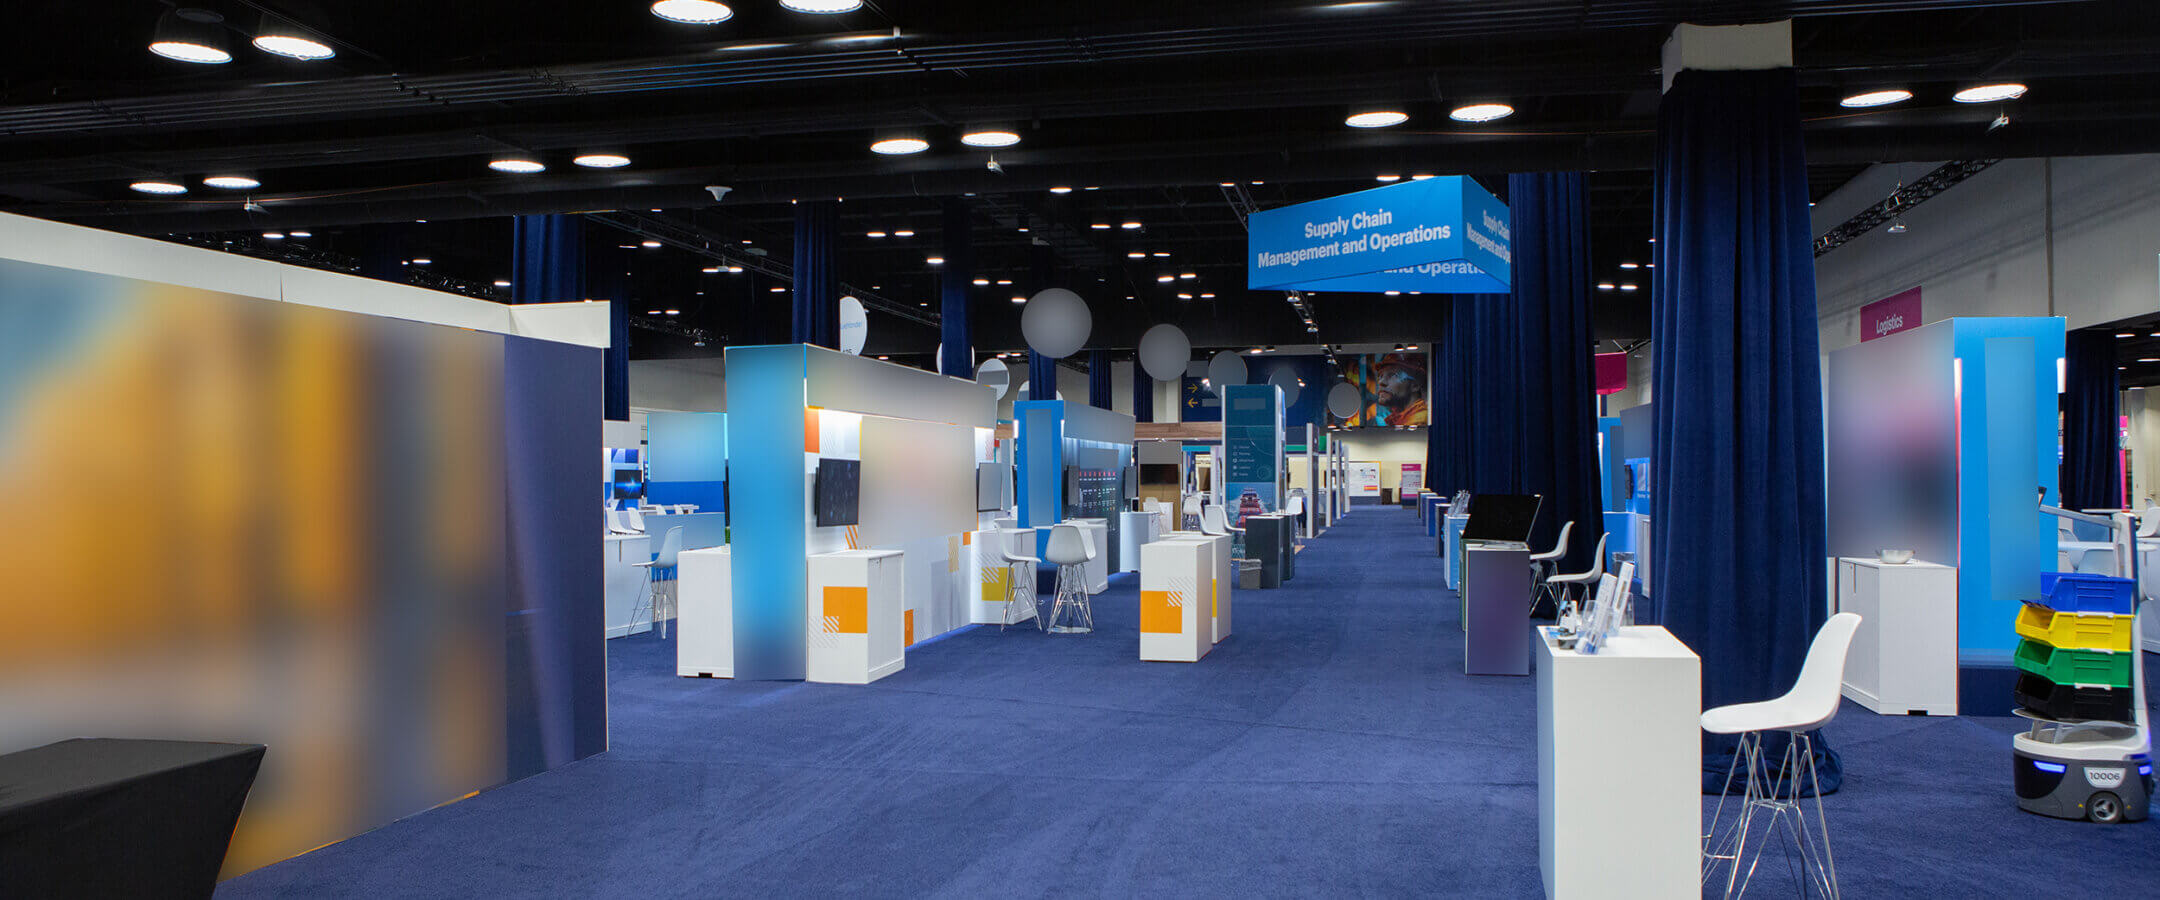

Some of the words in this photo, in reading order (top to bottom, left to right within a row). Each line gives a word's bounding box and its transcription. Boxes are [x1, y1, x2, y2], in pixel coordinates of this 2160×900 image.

[1305, 215, 1349, 239] Supply
[1352, 208, 1392, 230] Chain
[1258, 241, 1340, 269] Management
[1342, 234, 1367, 254] and
[1370, 224, 1451, 252] Operations
[1876, 313, 1903, 336] Logistics
[2090, 772, 2120, 780] 10006
